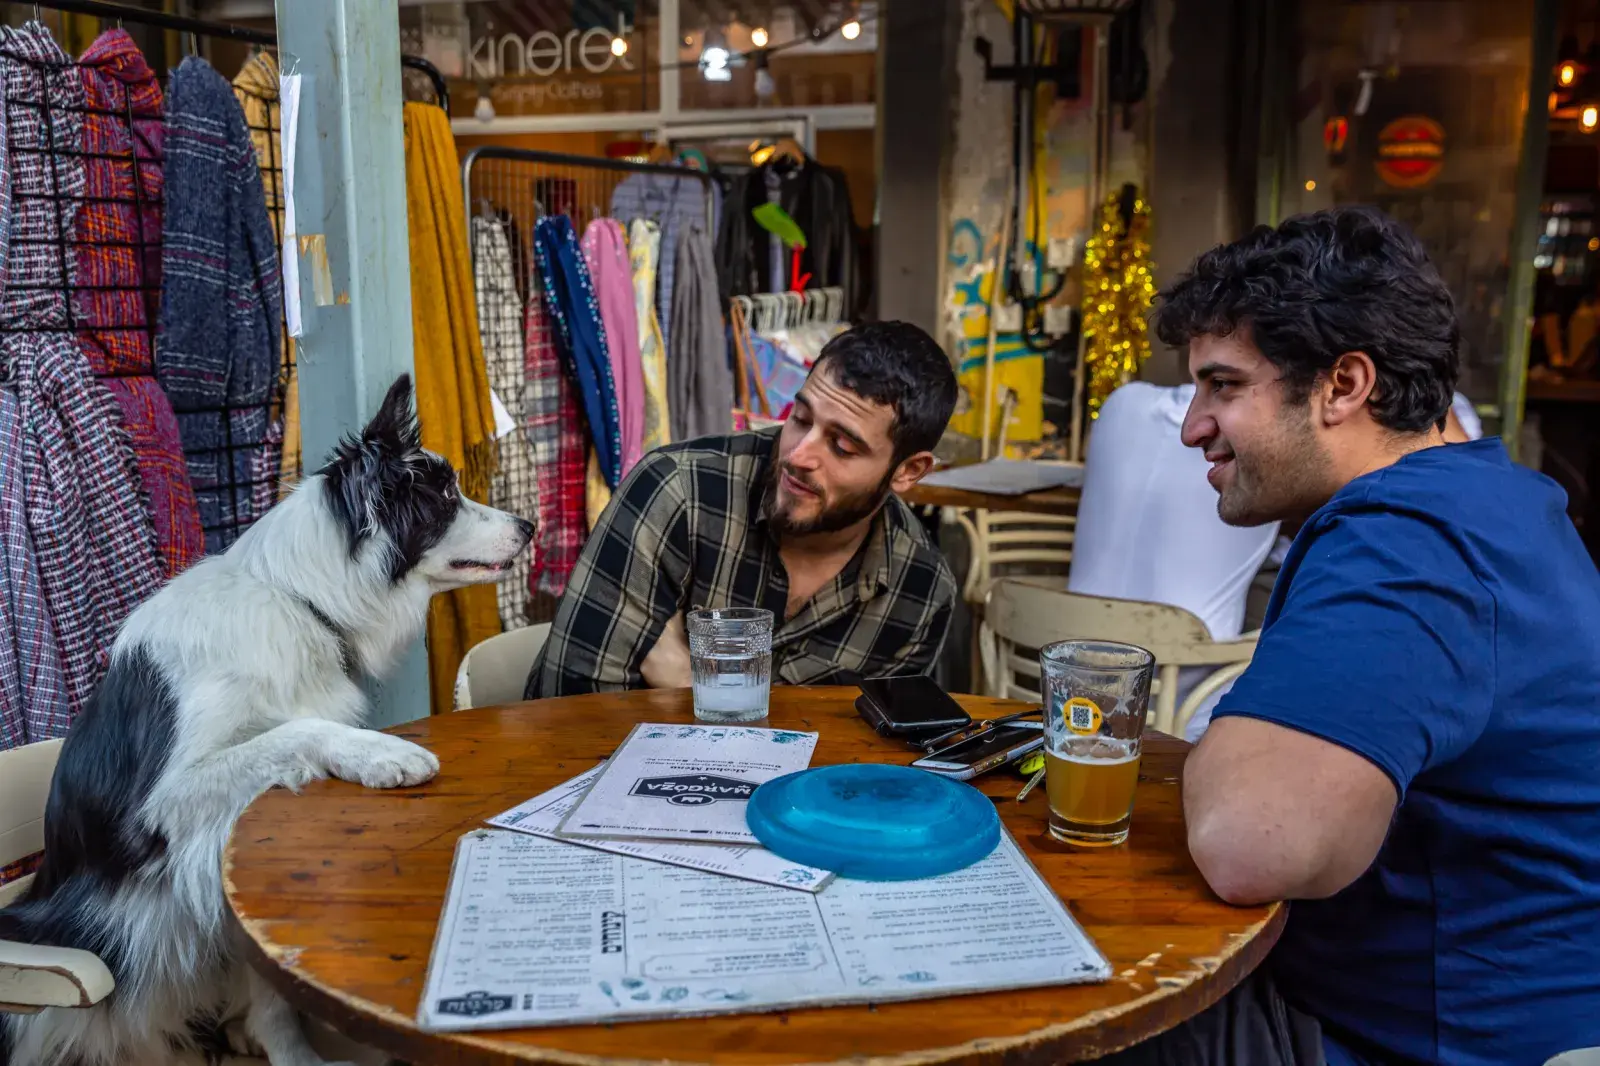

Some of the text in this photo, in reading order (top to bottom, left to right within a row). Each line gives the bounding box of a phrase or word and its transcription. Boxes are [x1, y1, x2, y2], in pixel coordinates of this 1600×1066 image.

[466, 11, 634, 79] kineret
[705, 766, 748, 774] Alcohol
[601, 911, 626, 953] קינוחים
